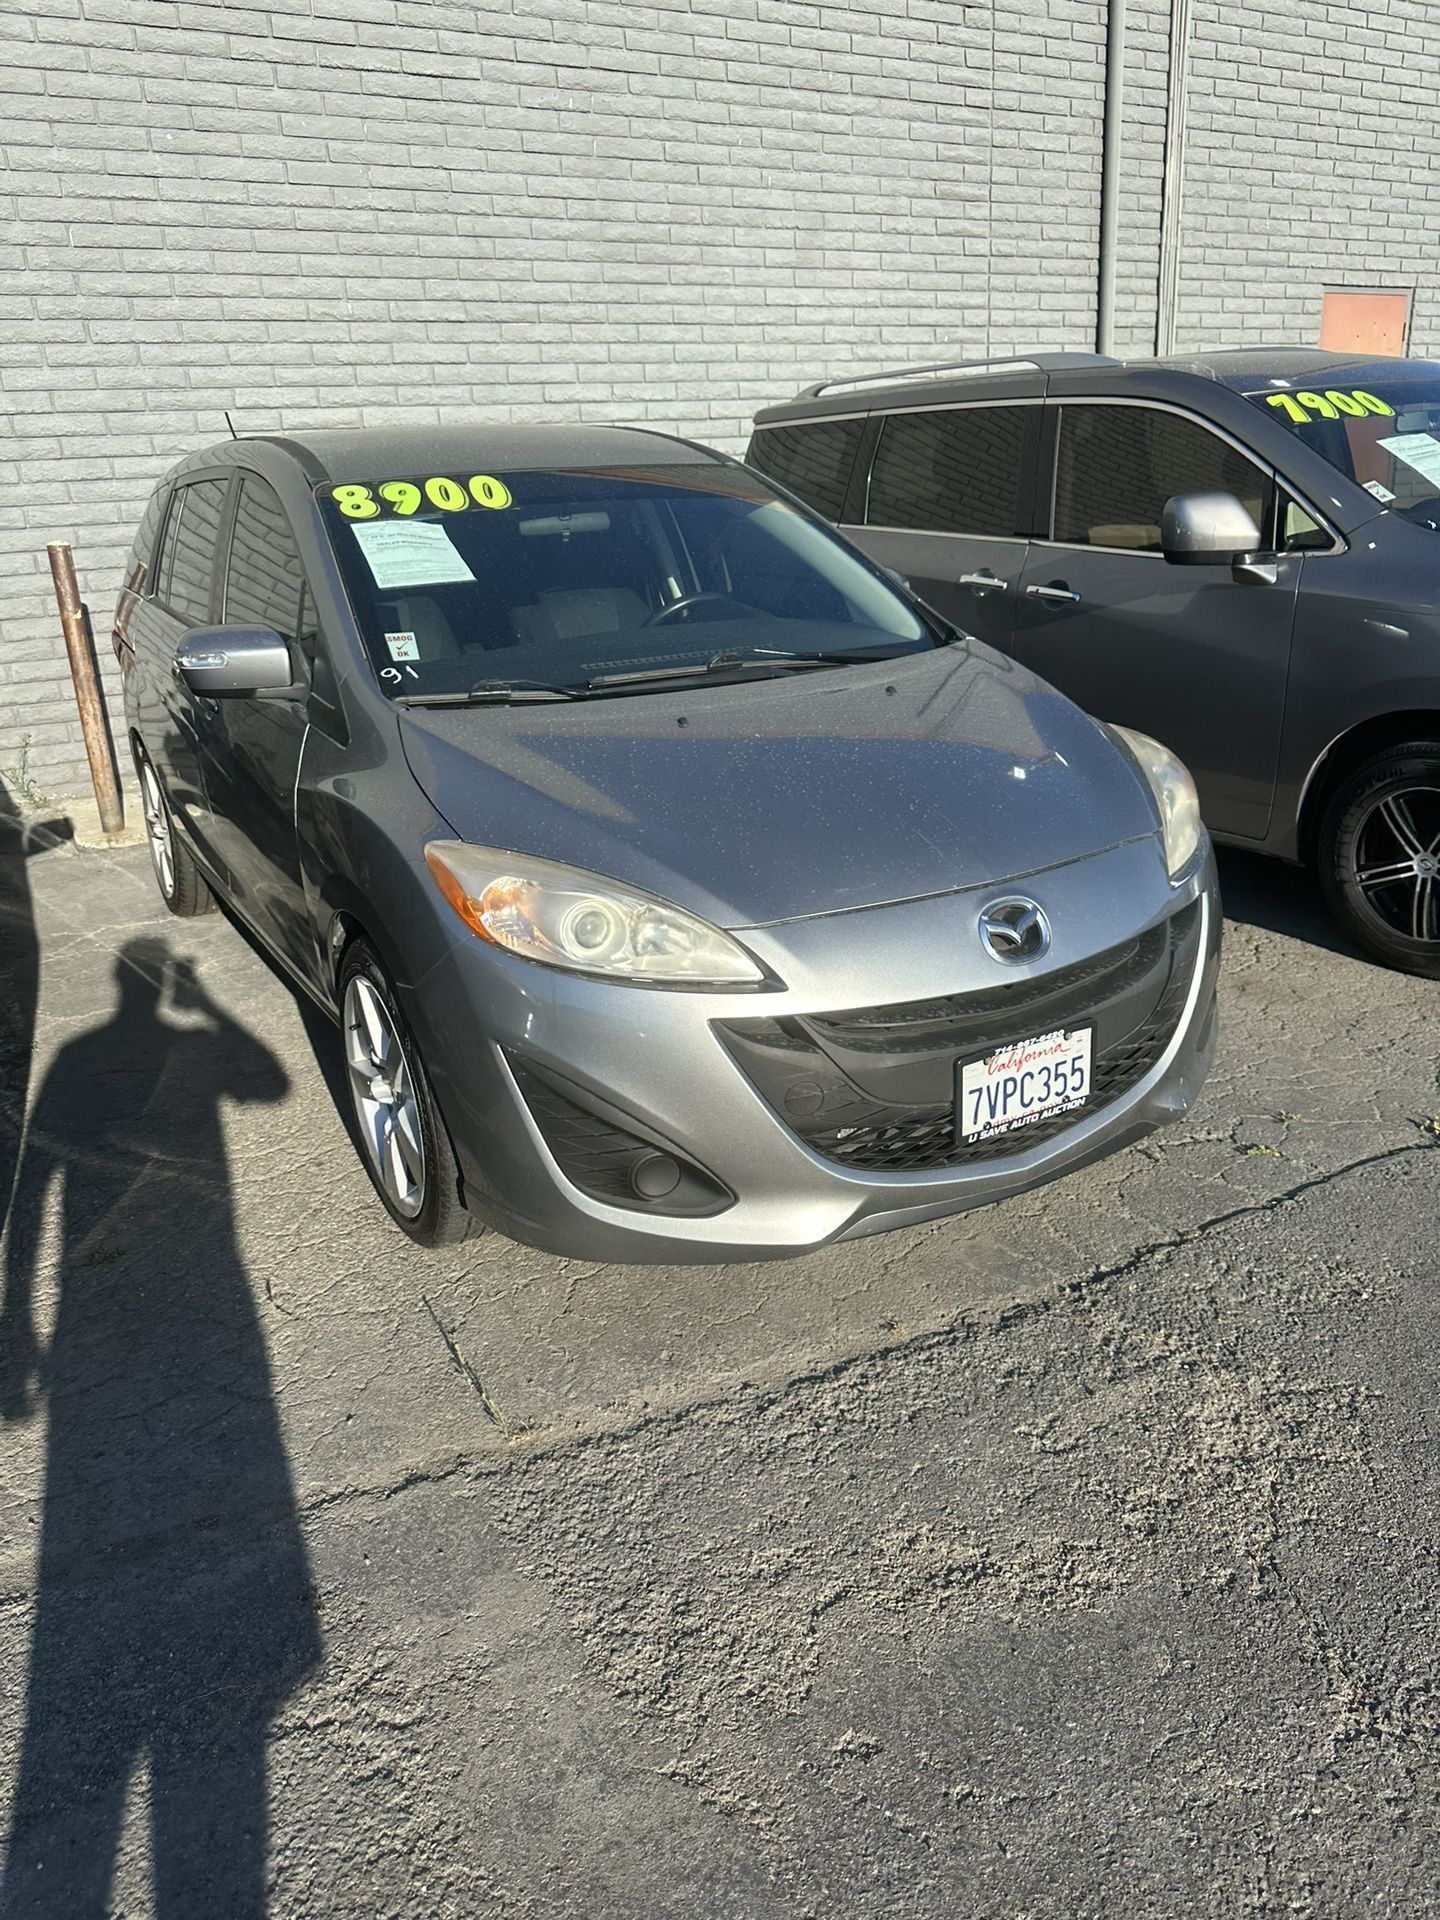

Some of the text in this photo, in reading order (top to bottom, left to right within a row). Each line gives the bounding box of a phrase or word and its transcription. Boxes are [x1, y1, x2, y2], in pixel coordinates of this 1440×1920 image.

[1266, 391, 1396, 423] 7900
[332, 475, 512, 519] 8900
[987, 1042, 1071, 1076] California
[968, 1054, 1084, 1125] 7VPC355
[968, 1097, 1087, 1143] U SAVE AUTO AUCTION
